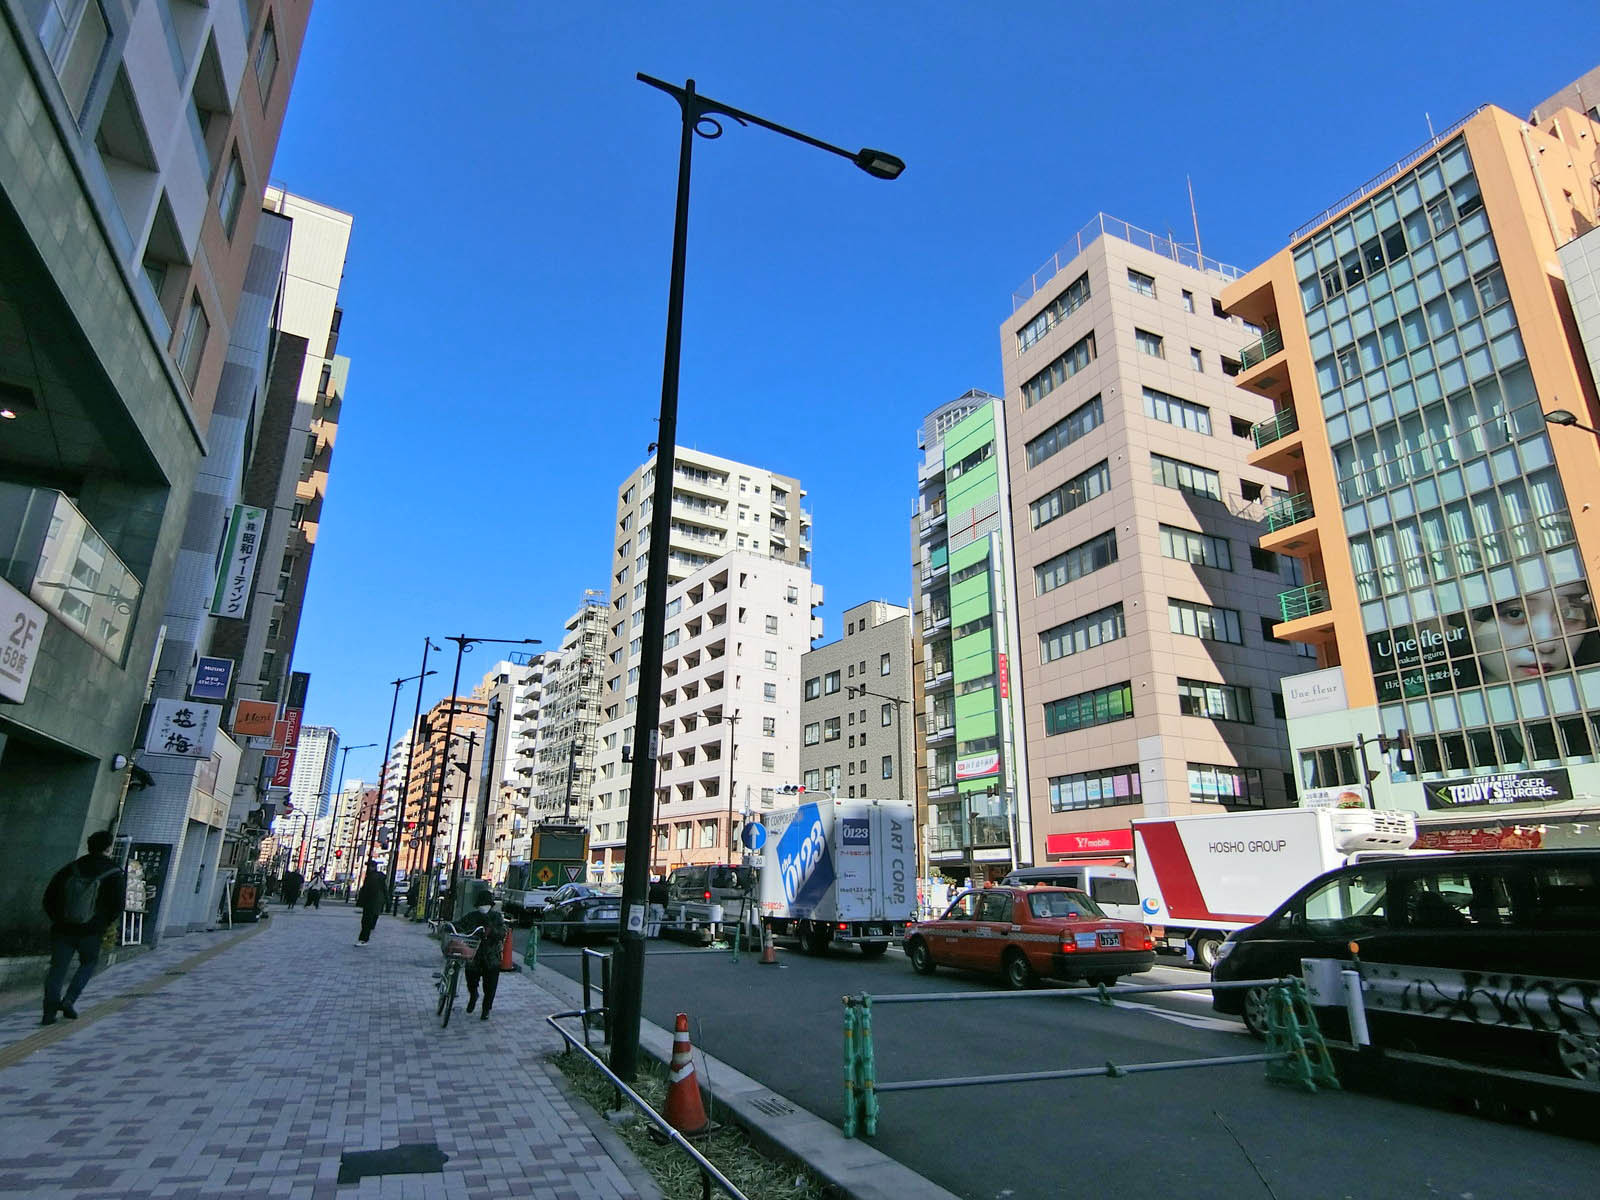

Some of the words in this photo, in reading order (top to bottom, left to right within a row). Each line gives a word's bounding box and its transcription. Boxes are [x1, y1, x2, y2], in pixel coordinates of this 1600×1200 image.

[9, 612, 37, 648] 2F
[1377, 639, 1417, 657] Une
[1420, 627, 1464, 648] fleur
[1448, 781, 1503, 803] TEDDY'S
[1503, 778, 1544, 789] BIGGER
[1504, 786, 1552, 797] BURGERS
[890, 819, 904, 854] ART
[1208, 841, 1245, 853] HOSHO
[1248, 840, 1286, 852] GROUP
[785, 820, 825, 903] 0123
